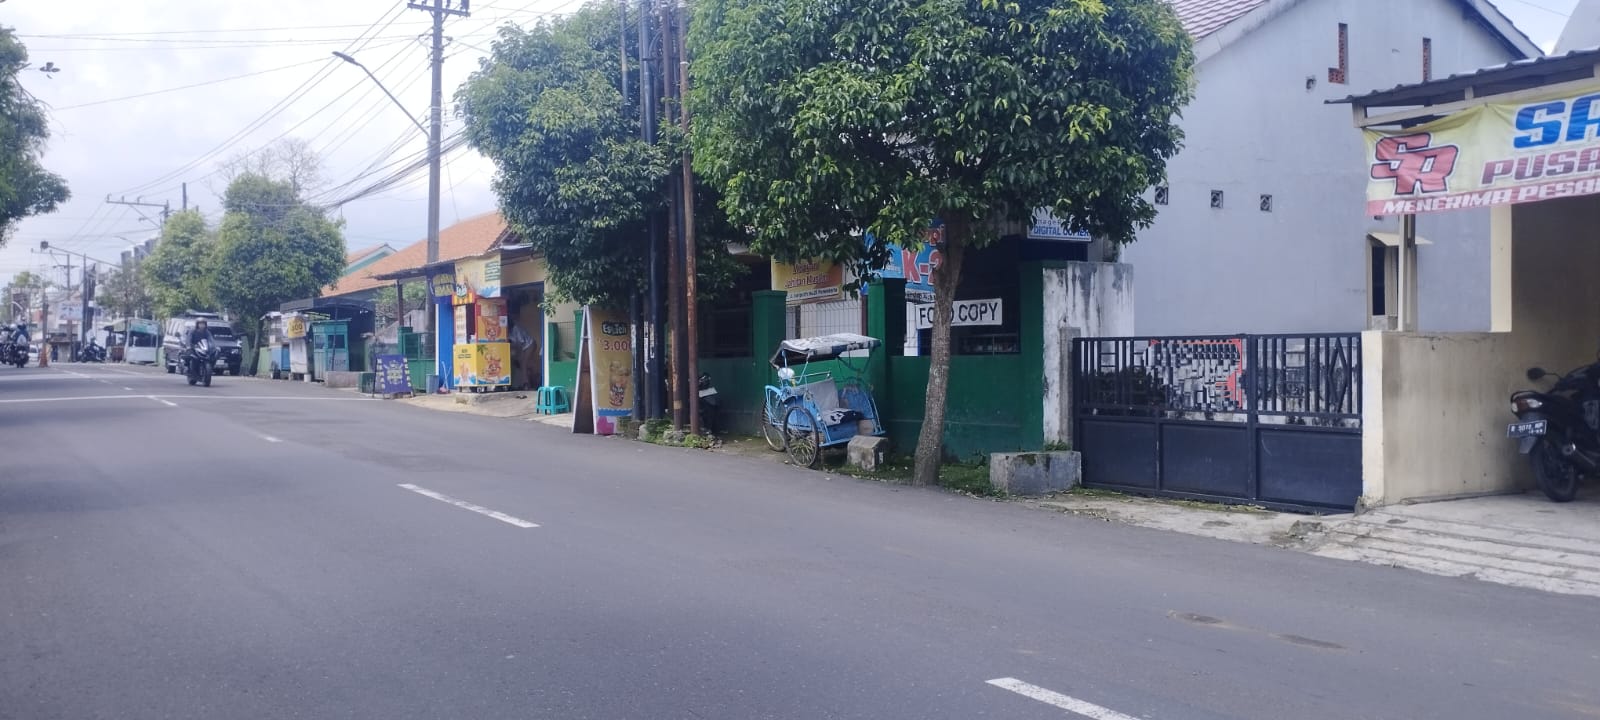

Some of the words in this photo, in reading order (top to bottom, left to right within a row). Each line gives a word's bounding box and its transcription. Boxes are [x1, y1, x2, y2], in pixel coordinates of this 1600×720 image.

[1383, 189, 1511, 214] MENERIMA
[1518, 178, 1600, 201] PESA
[1034, 225, 1061, 236] DIGITAL
[959, 303, 998, 321] COPY
[603, 340, 632, 351] 3.00
